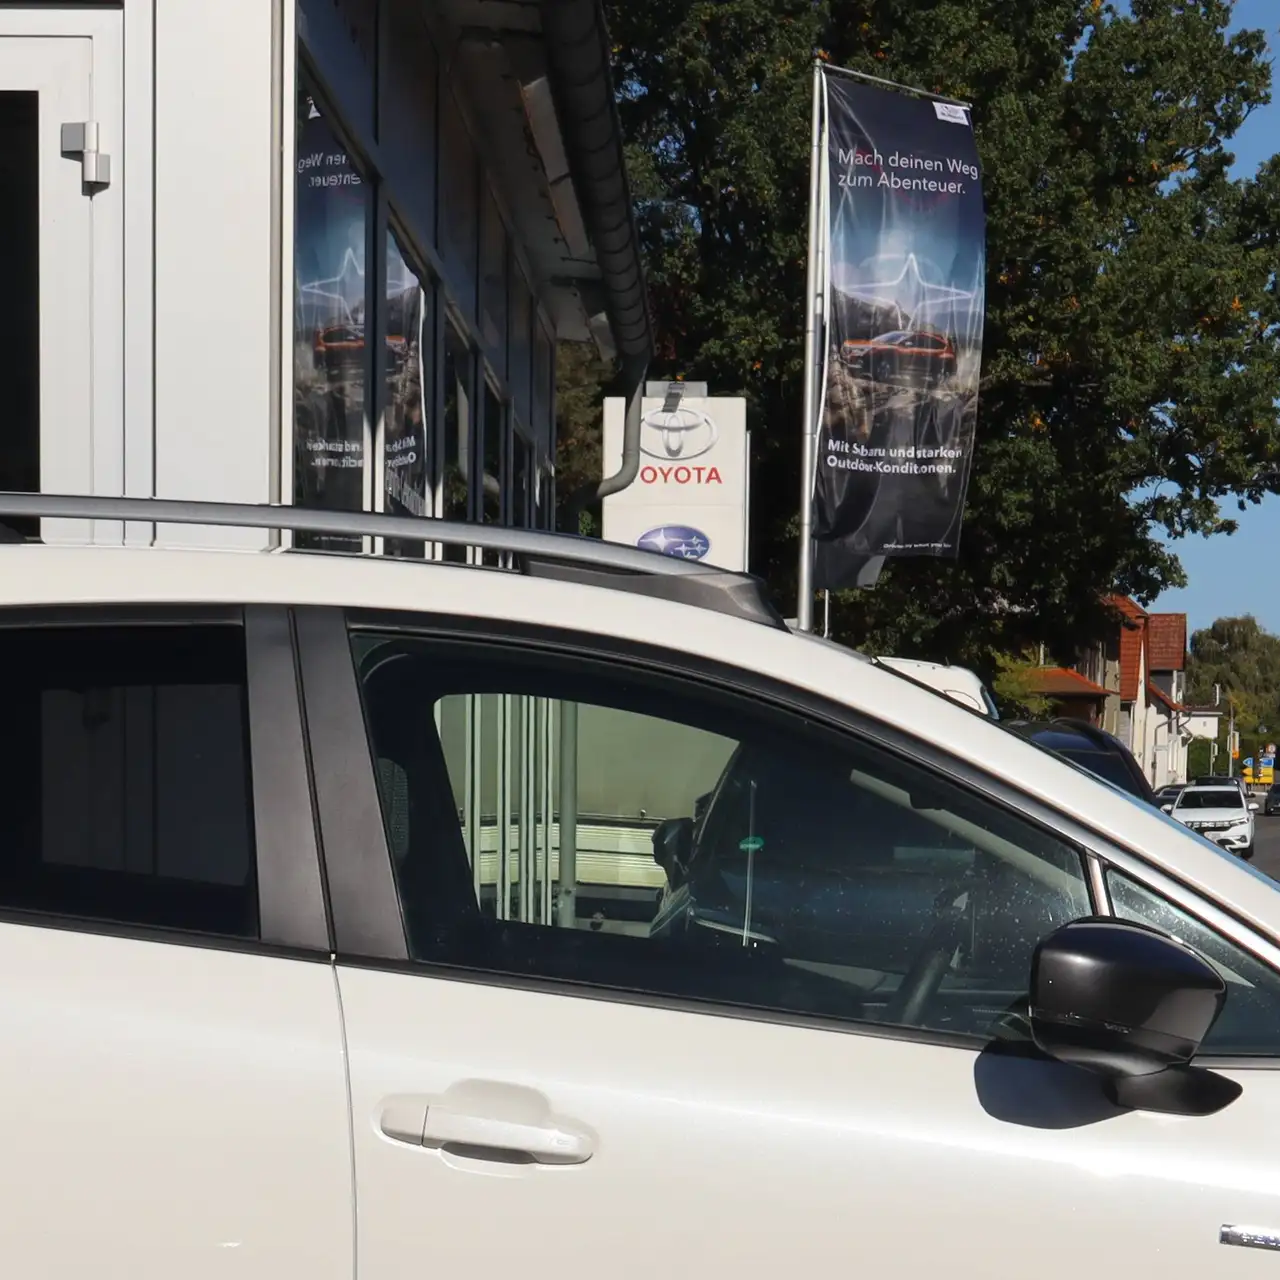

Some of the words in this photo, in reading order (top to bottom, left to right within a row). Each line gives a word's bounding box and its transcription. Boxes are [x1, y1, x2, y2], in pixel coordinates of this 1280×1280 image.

[838, 148, 883, 166] Mach
[888, 151, 943, 172] deinen
[946, 158, 979, 180] Weg
[838, 174, 873, 187] zum
[877, 171, 966, 194] Abenteuer.
[827, 438, 850, 454] Mit
[889, 446, 915, 458] und
[640, 466, 723, 484] OYOTA
